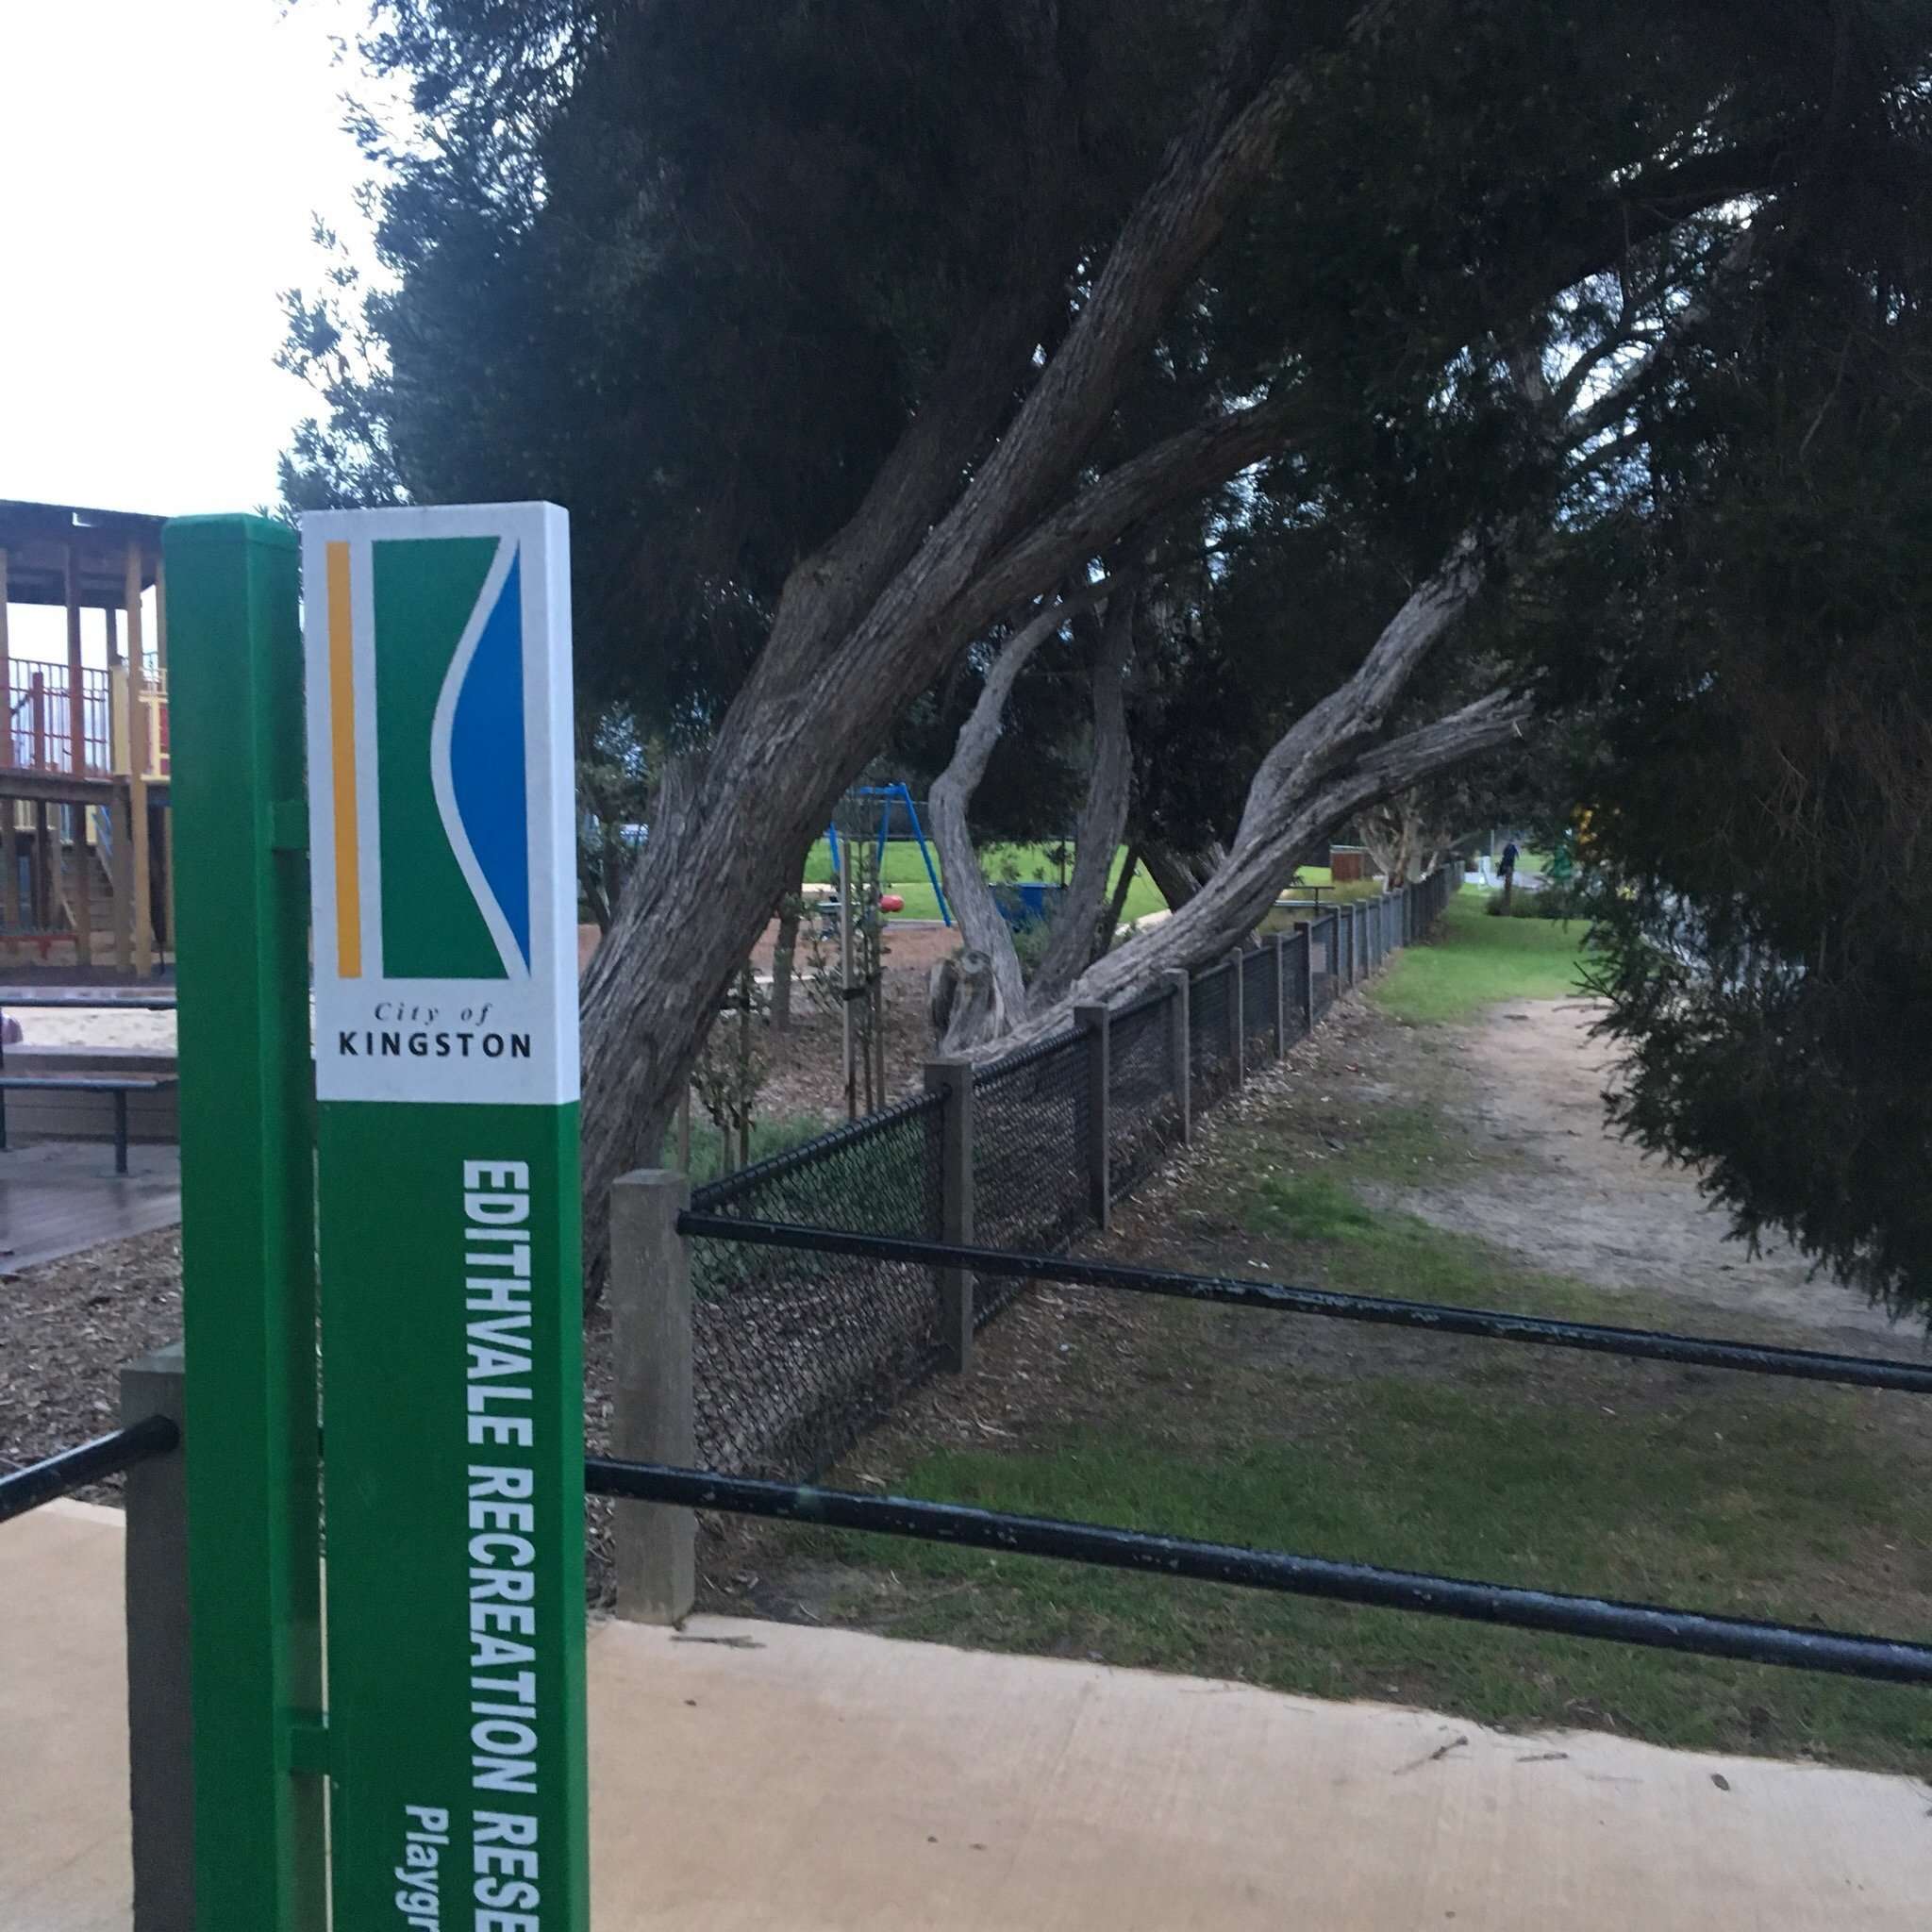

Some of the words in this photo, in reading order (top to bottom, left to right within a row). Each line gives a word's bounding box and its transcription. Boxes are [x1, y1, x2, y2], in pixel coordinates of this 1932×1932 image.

[339, 1031, 532, 1058] KINGSTON
[375, 1002, 440, 1025] City
[460, 1003, 493, 1026] of
[463, 1159, 533, 1447] EDITHVALE
[468, 1464, 538, 1793] RECREATION
